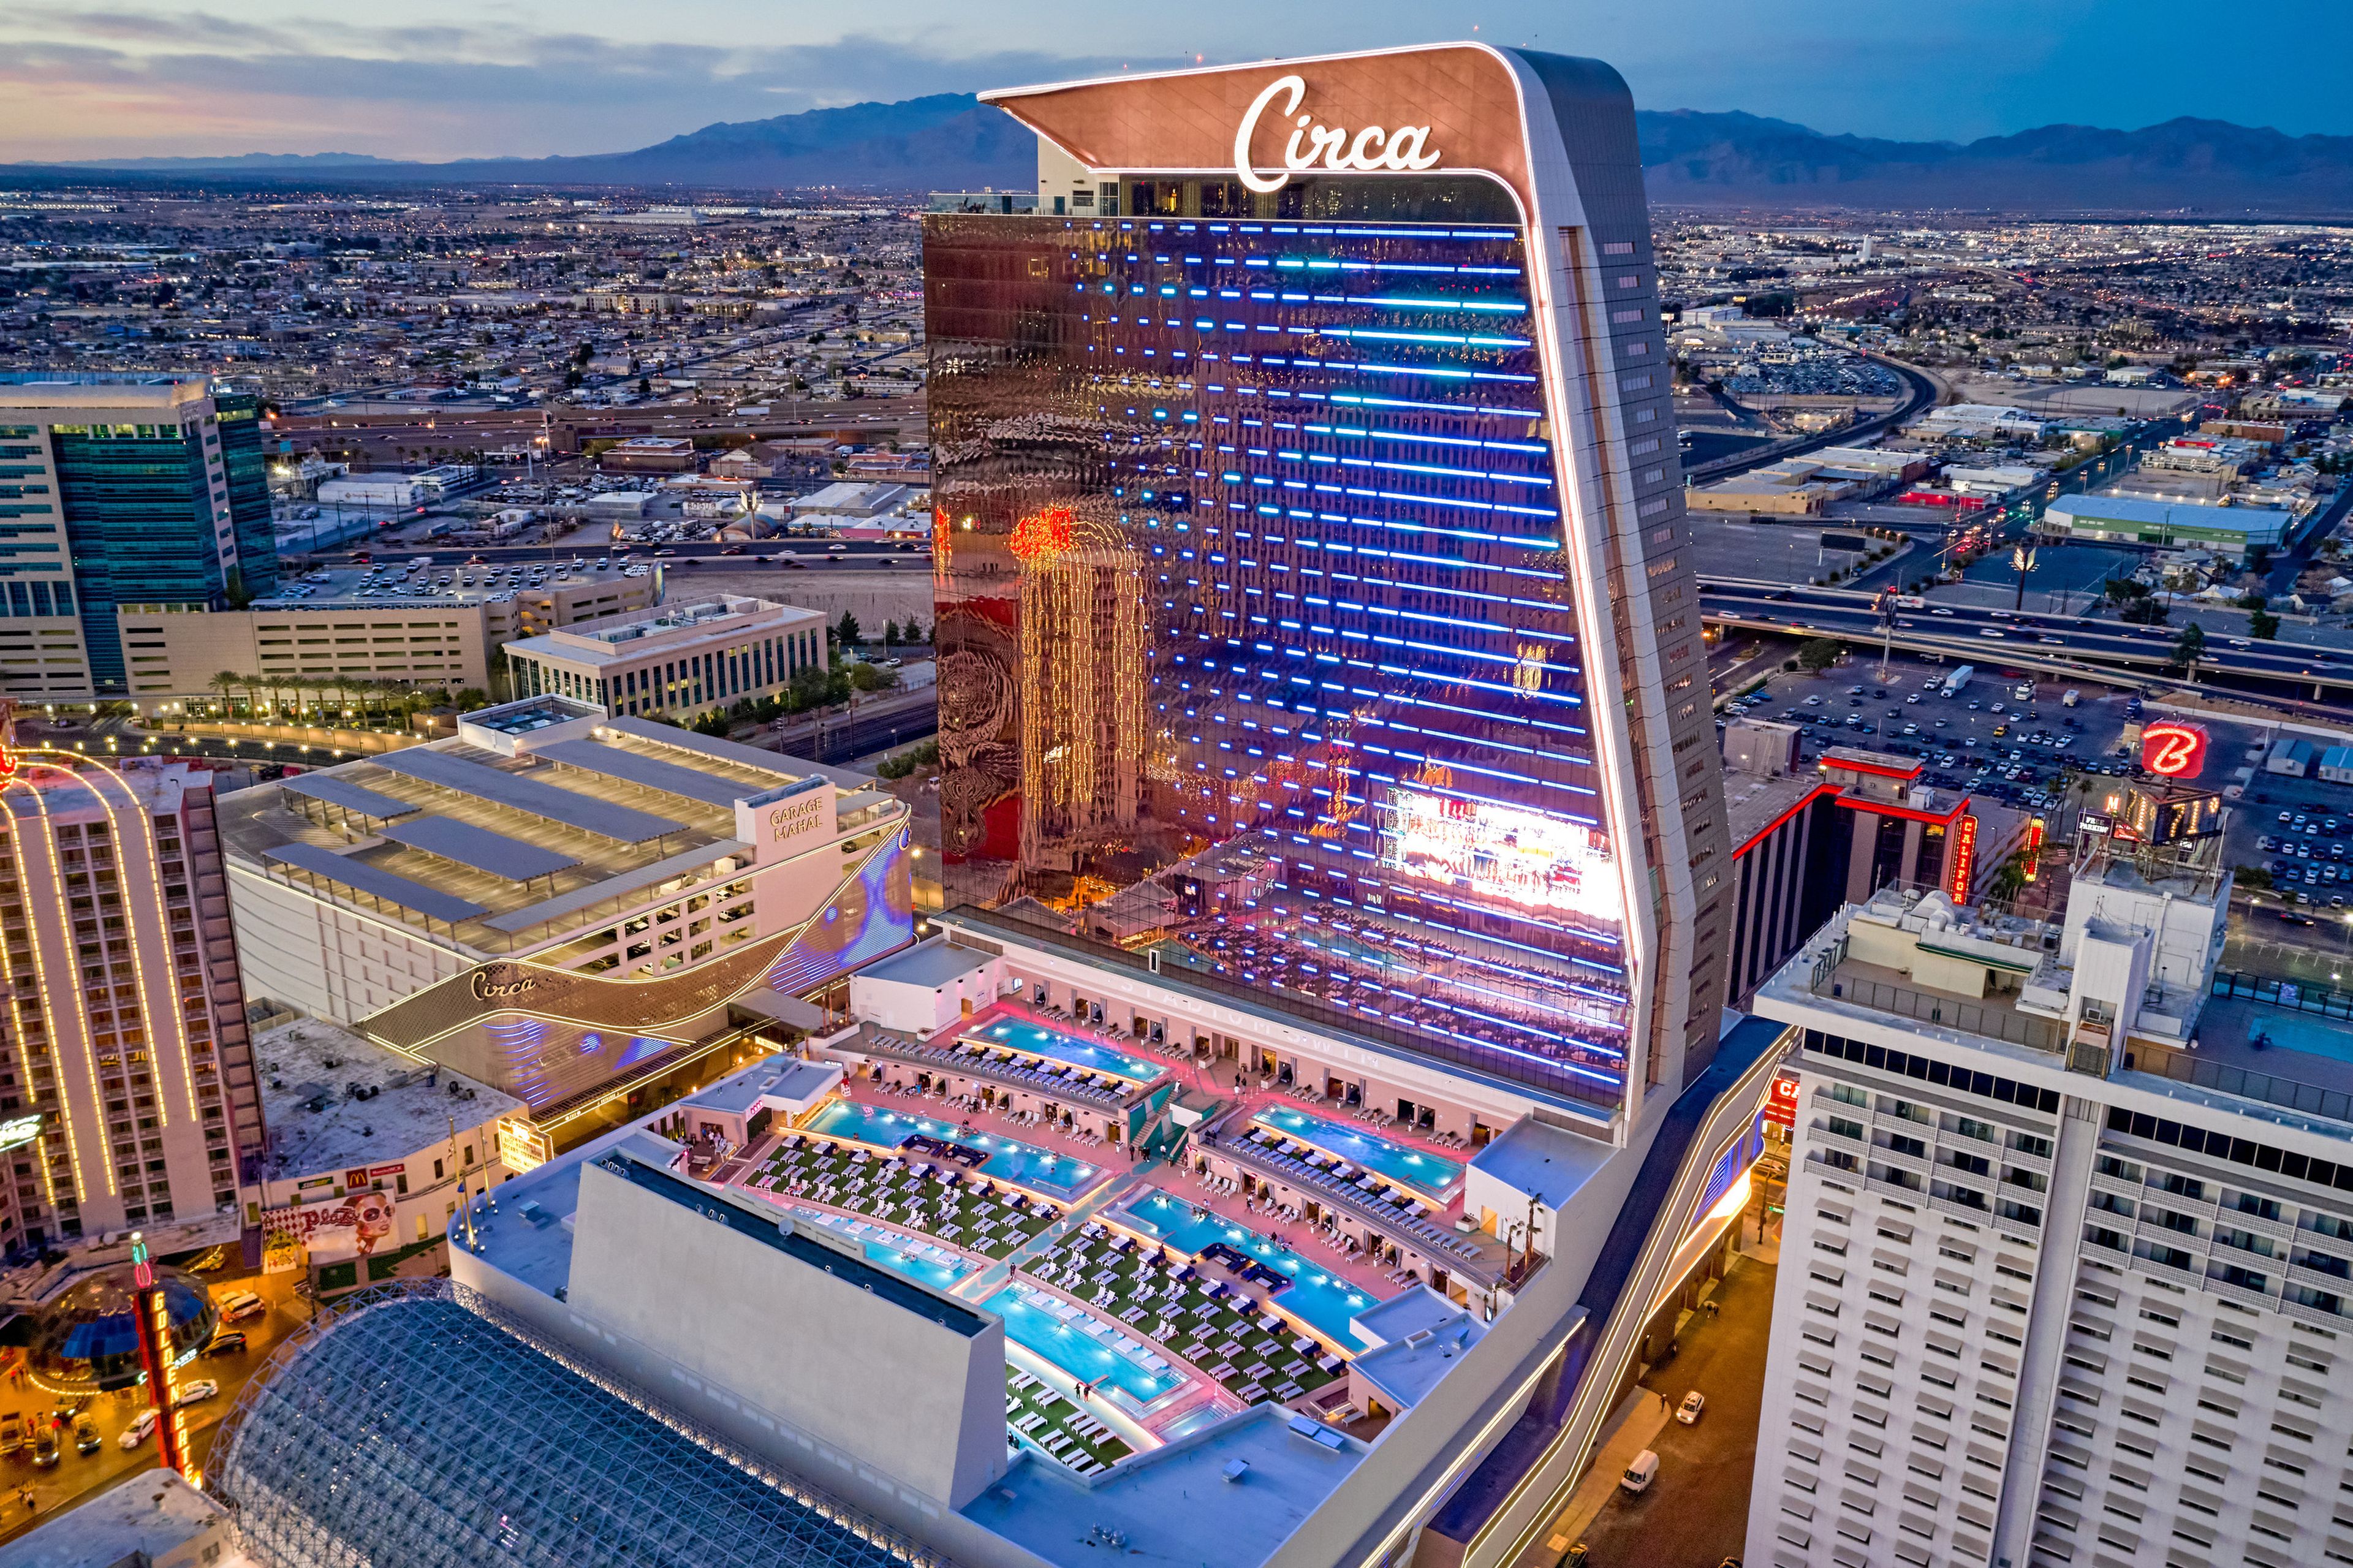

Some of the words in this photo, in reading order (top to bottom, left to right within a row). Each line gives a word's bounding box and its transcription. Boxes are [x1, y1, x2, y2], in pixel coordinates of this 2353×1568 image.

[1234, 75, 1441, 193] Circa
[2142, 727, 2198, 774] B
[770, 797, 822, 827] GARAGE
[775, 815, 822, 842] MAHAL
[2079, 822, 2109, 833] PARKING
[471, 972, 537, 1001] Circa
[1121, 983, 1270, 1034] STADIUM
[1287, 1034, 1379, 1067] SWIM
[154, 1290, 180, 1404] GOLDEN
[175, 1410, 194, 1482] GATE
